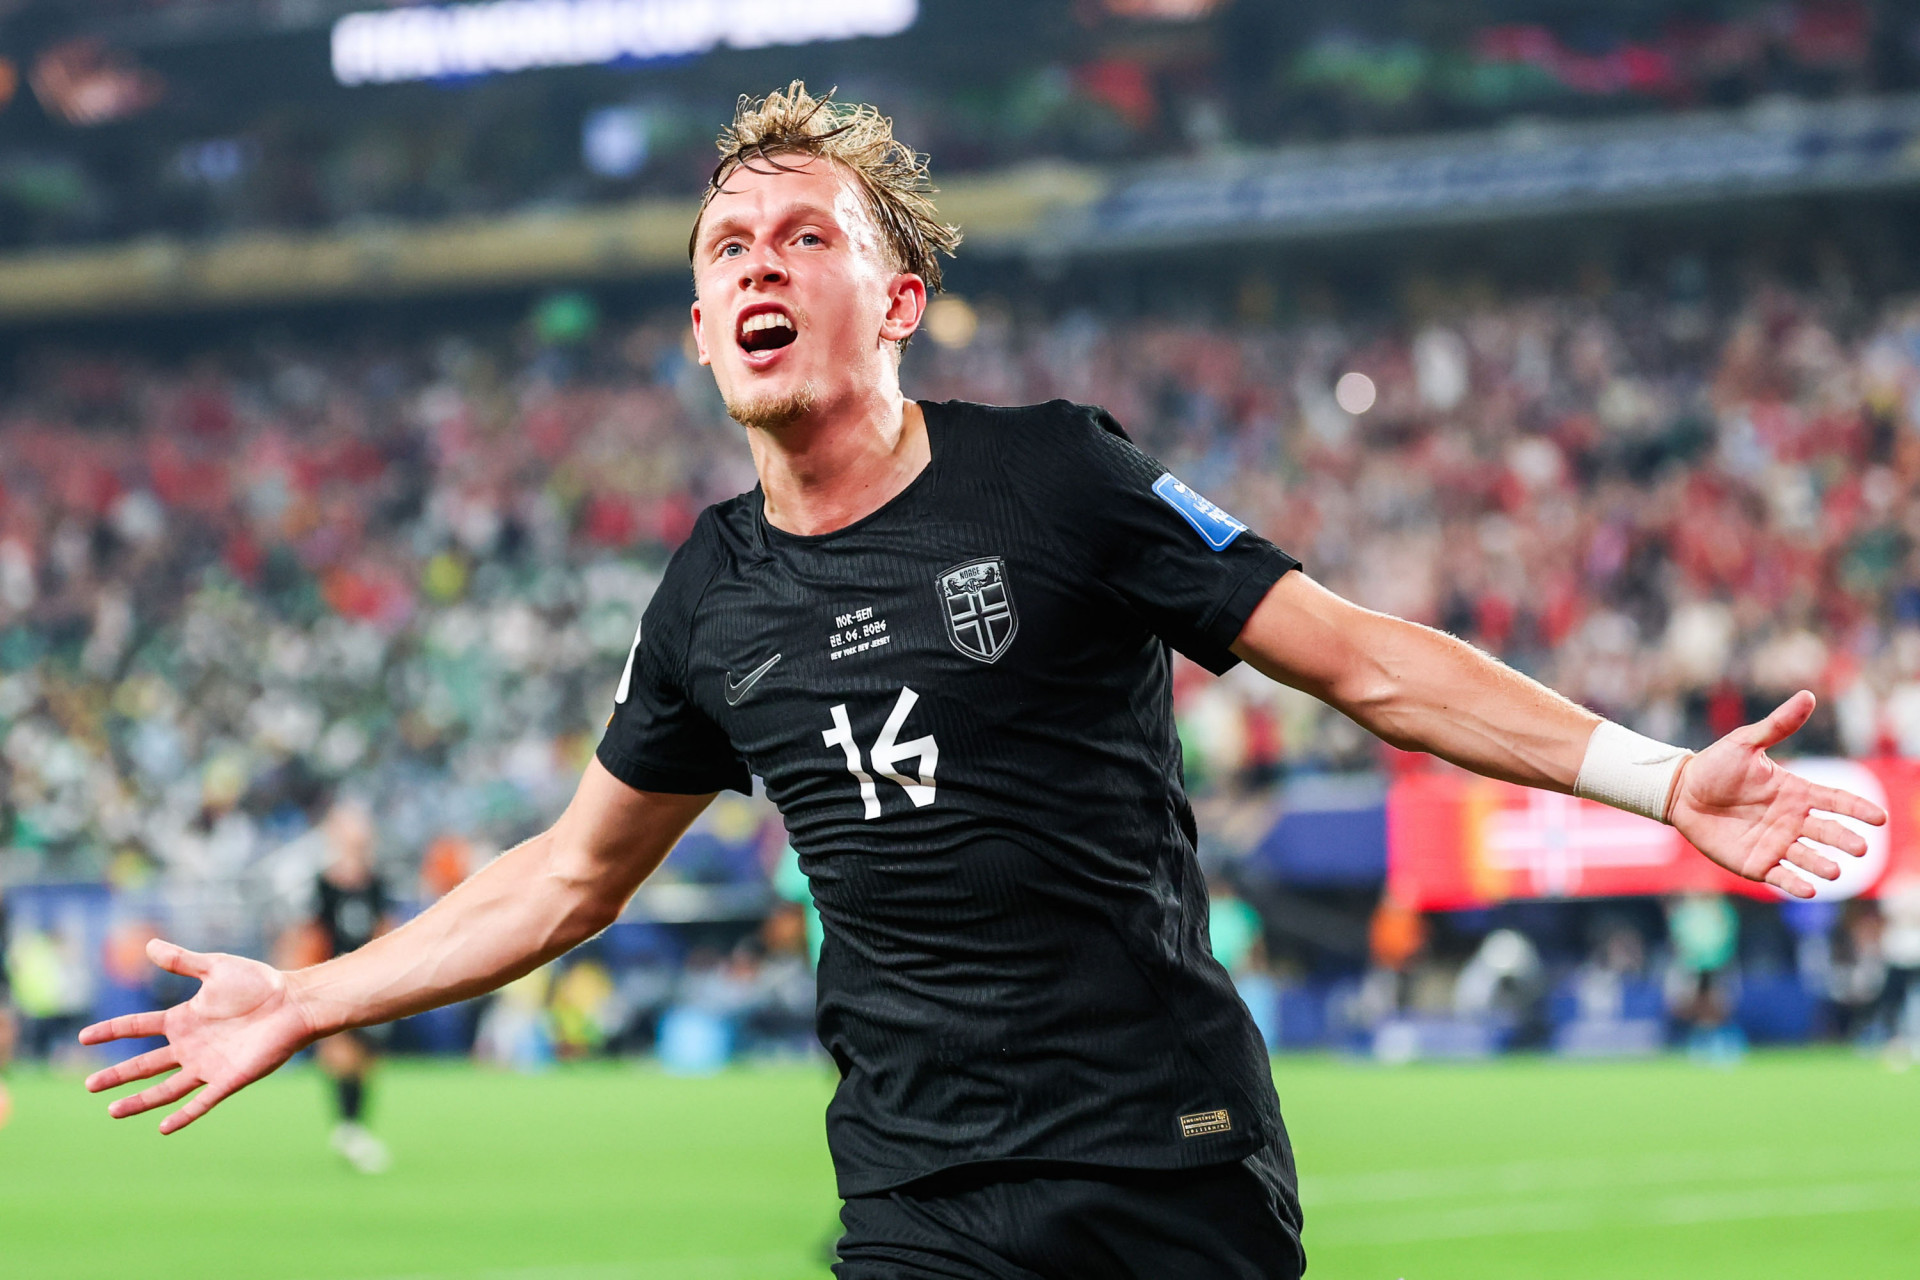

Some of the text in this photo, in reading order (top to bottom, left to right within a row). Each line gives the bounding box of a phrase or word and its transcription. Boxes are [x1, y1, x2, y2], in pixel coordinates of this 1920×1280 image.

[959, 566, 981, 580] NORGE
[835, 606, 873, 629] NOR-SEN
[830, 635, 891, 661] NEW YORK NEW JERSEY
[821, 685, 939, 820] 16
